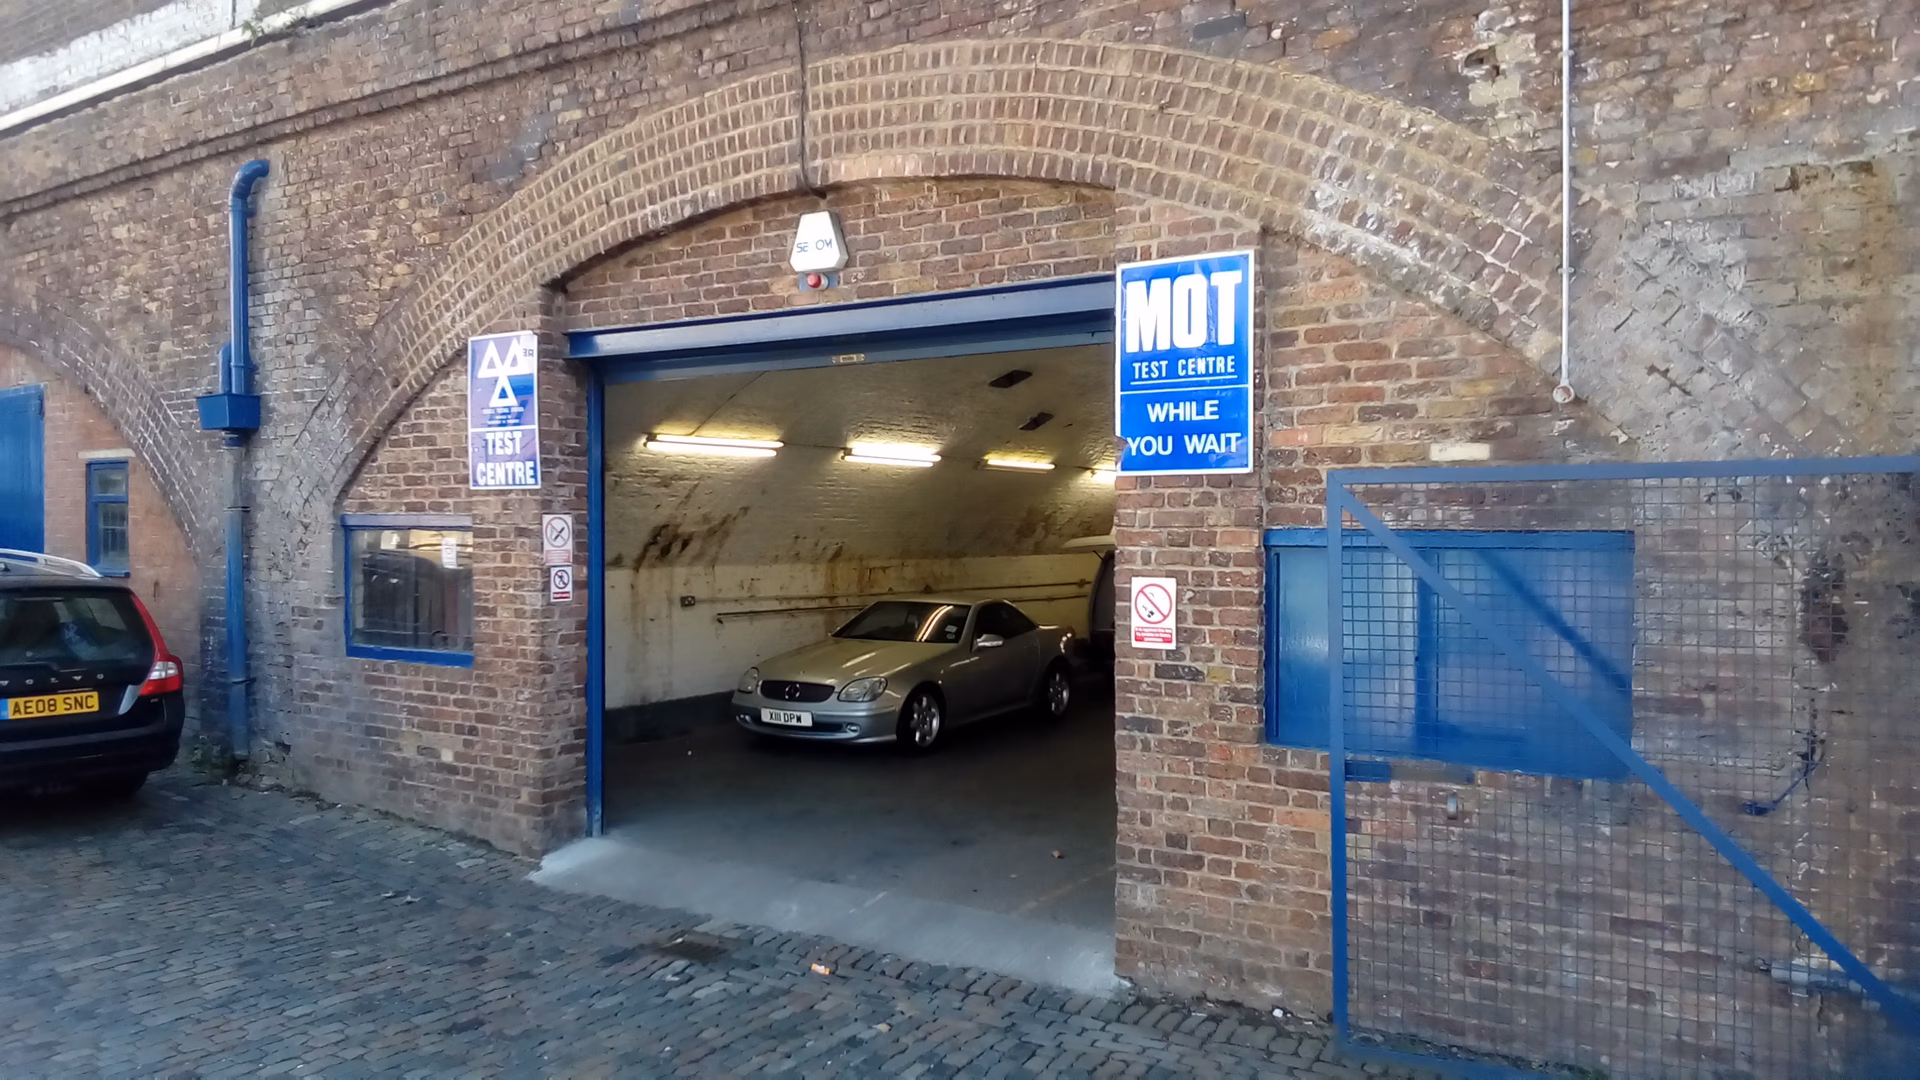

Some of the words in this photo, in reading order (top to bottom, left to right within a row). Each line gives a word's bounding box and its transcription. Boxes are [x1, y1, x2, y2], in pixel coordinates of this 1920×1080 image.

[1125, 270, 1242, 353] MOT
[1132, 361, 1168, 379] TEST
[1178, 356, 1235, 376] CENTRE
[1146, 400, 1219, 422] WHILE
[485, 431, 522, 455] TEST
[1126, 435, 1173, 456] YOU
[1184, 432, 1241, 454] WAIT
[476, 461, 536, 485] CENTRE
[0, 673, 104, 686] VOLVO
[12, 698, 57, 716] AE08
[62, 694, 95, 711] SNC
[783, 712, 802, 723] DPW
